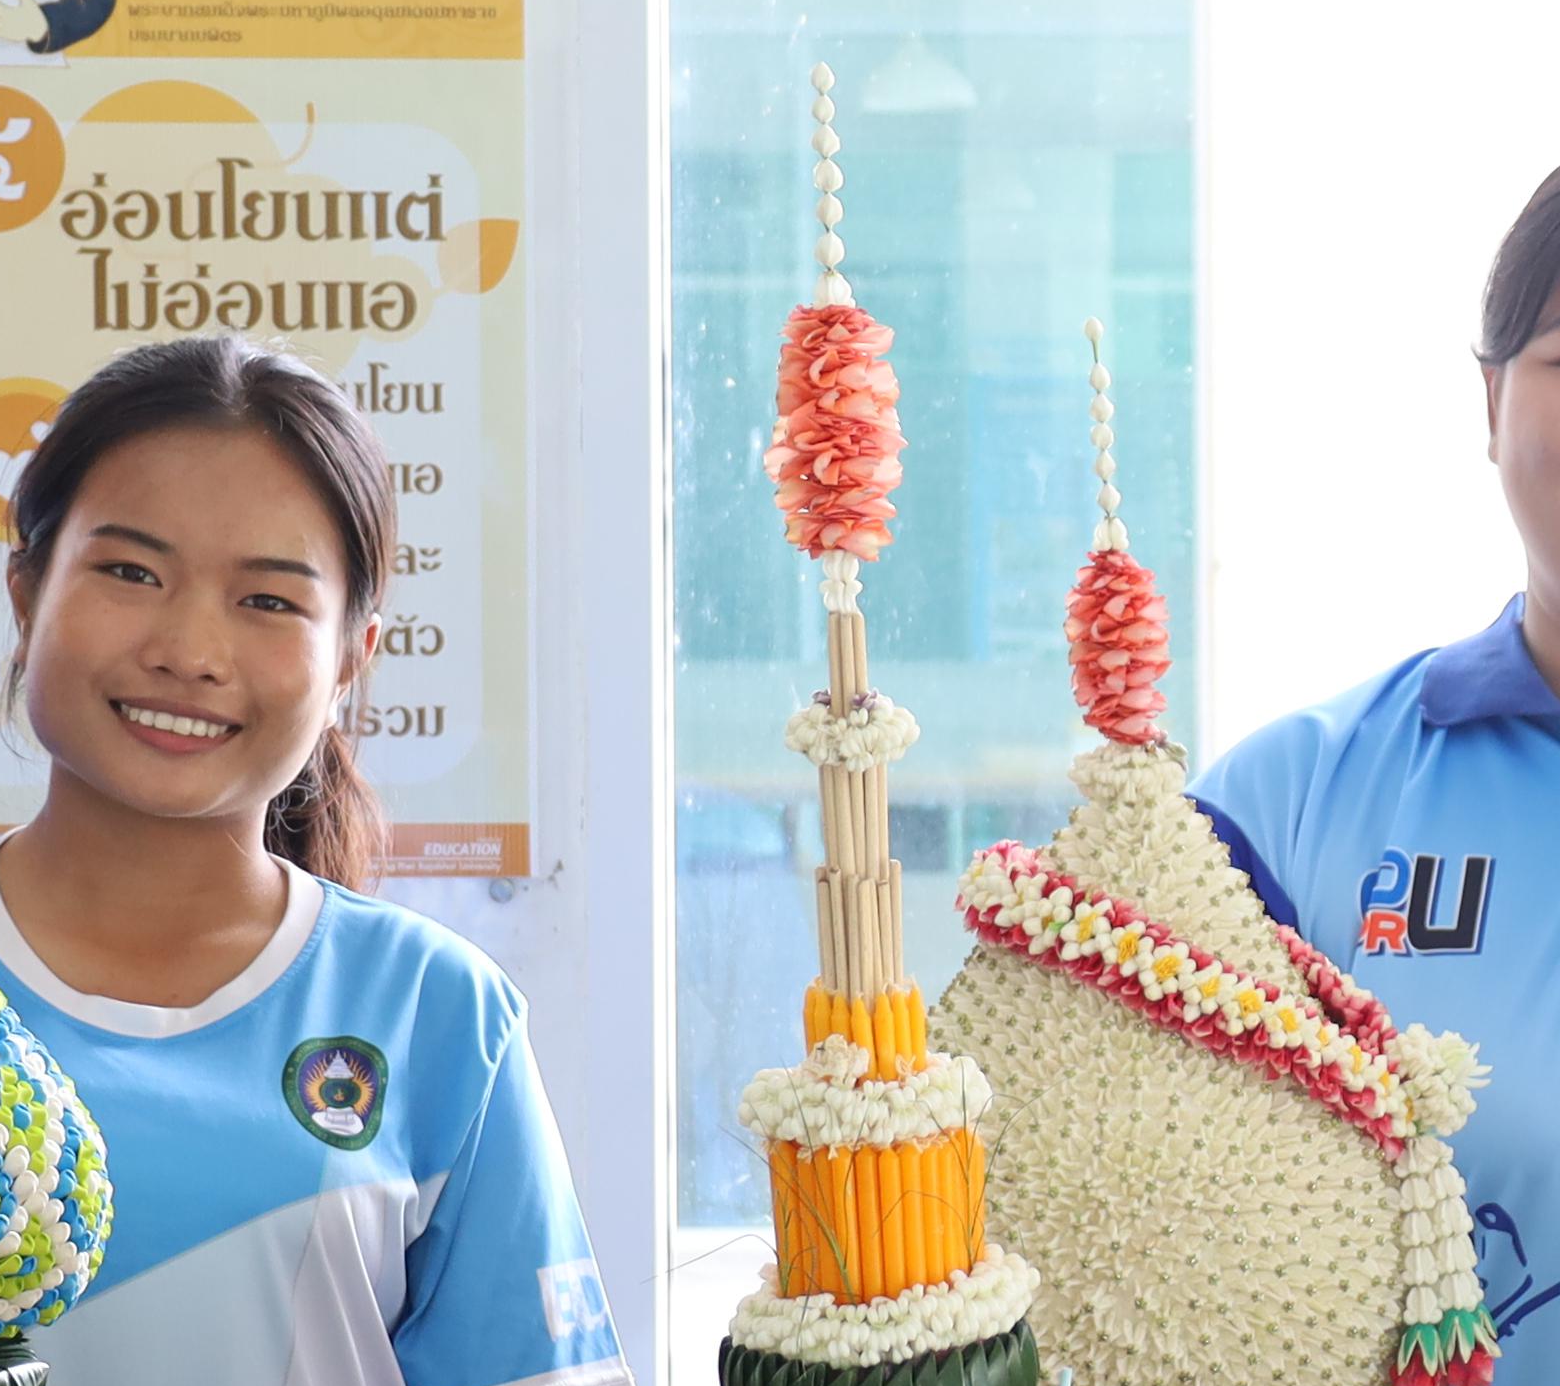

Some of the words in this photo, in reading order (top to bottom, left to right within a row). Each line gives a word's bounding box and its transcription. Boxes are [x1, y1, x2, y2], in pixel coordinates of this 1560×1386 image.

[60, 158, 447, 241] อ่อนโยนแต่
[75, 246, 418, 332] ไม่อ่อนแอ
[423, 841, 503, 857] EDUCATION
[1358, 846, 1496, 955] DU
